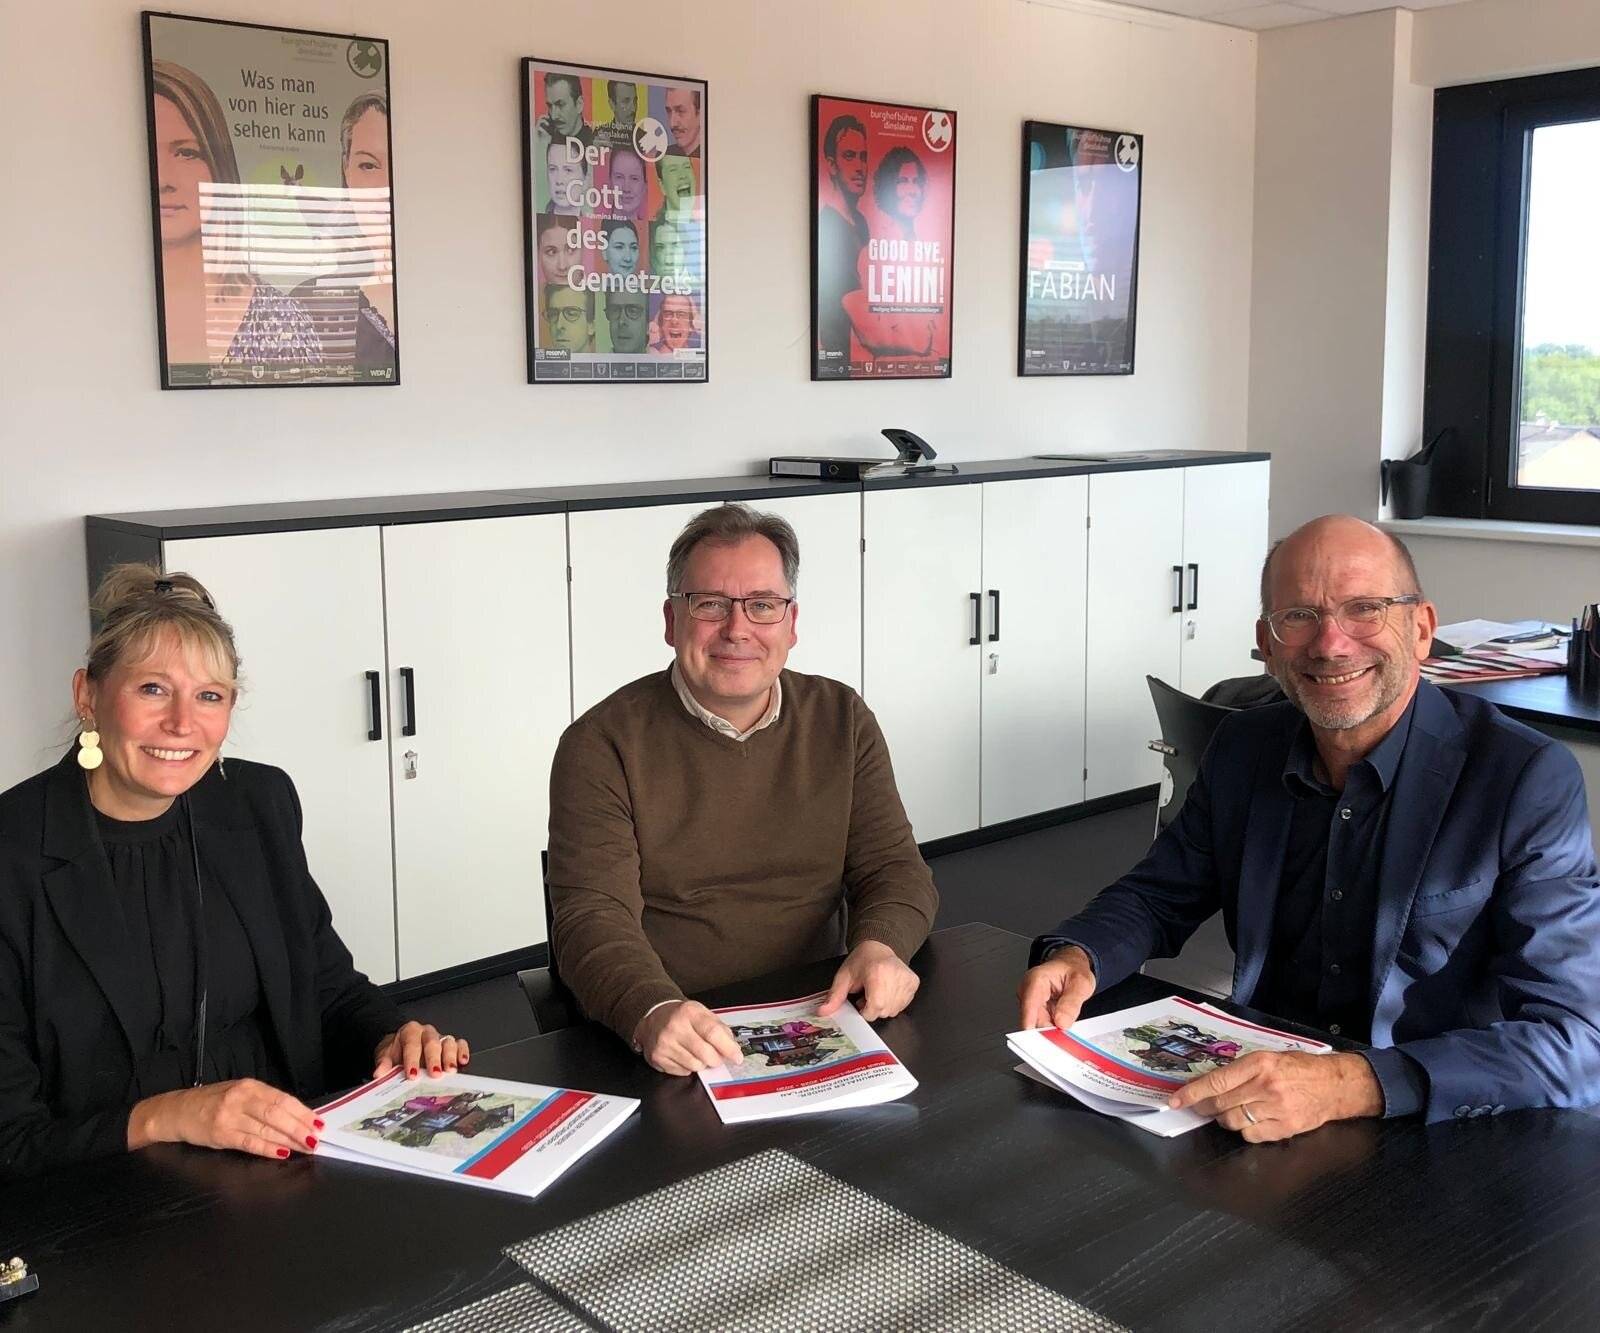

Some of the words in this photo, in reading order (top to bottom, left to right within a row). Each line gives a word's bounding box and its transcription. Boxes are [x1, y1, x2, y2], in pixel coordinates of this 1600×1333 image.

[240, 68, 275, 91] Was
[281, 78, 315, 94] man
[228, 97, 257, 113] von
[264, 96, 296, 116] hier
[302, 103, 329, 120] aus
[233, 120, 281, 140] sehen
[287, 122, 326, 144] kann
[565, 136, 611, 167] Der
[565, 178, 624, 210] Gott
[566, 221, 609, 250] des
[868, 238, 909, 261] GOOD
[567, 264, 693, 296] Gemetzels
[867, 264, 945, 304] LENIN!
[1028, 269, 1116, 301] FABIAN
